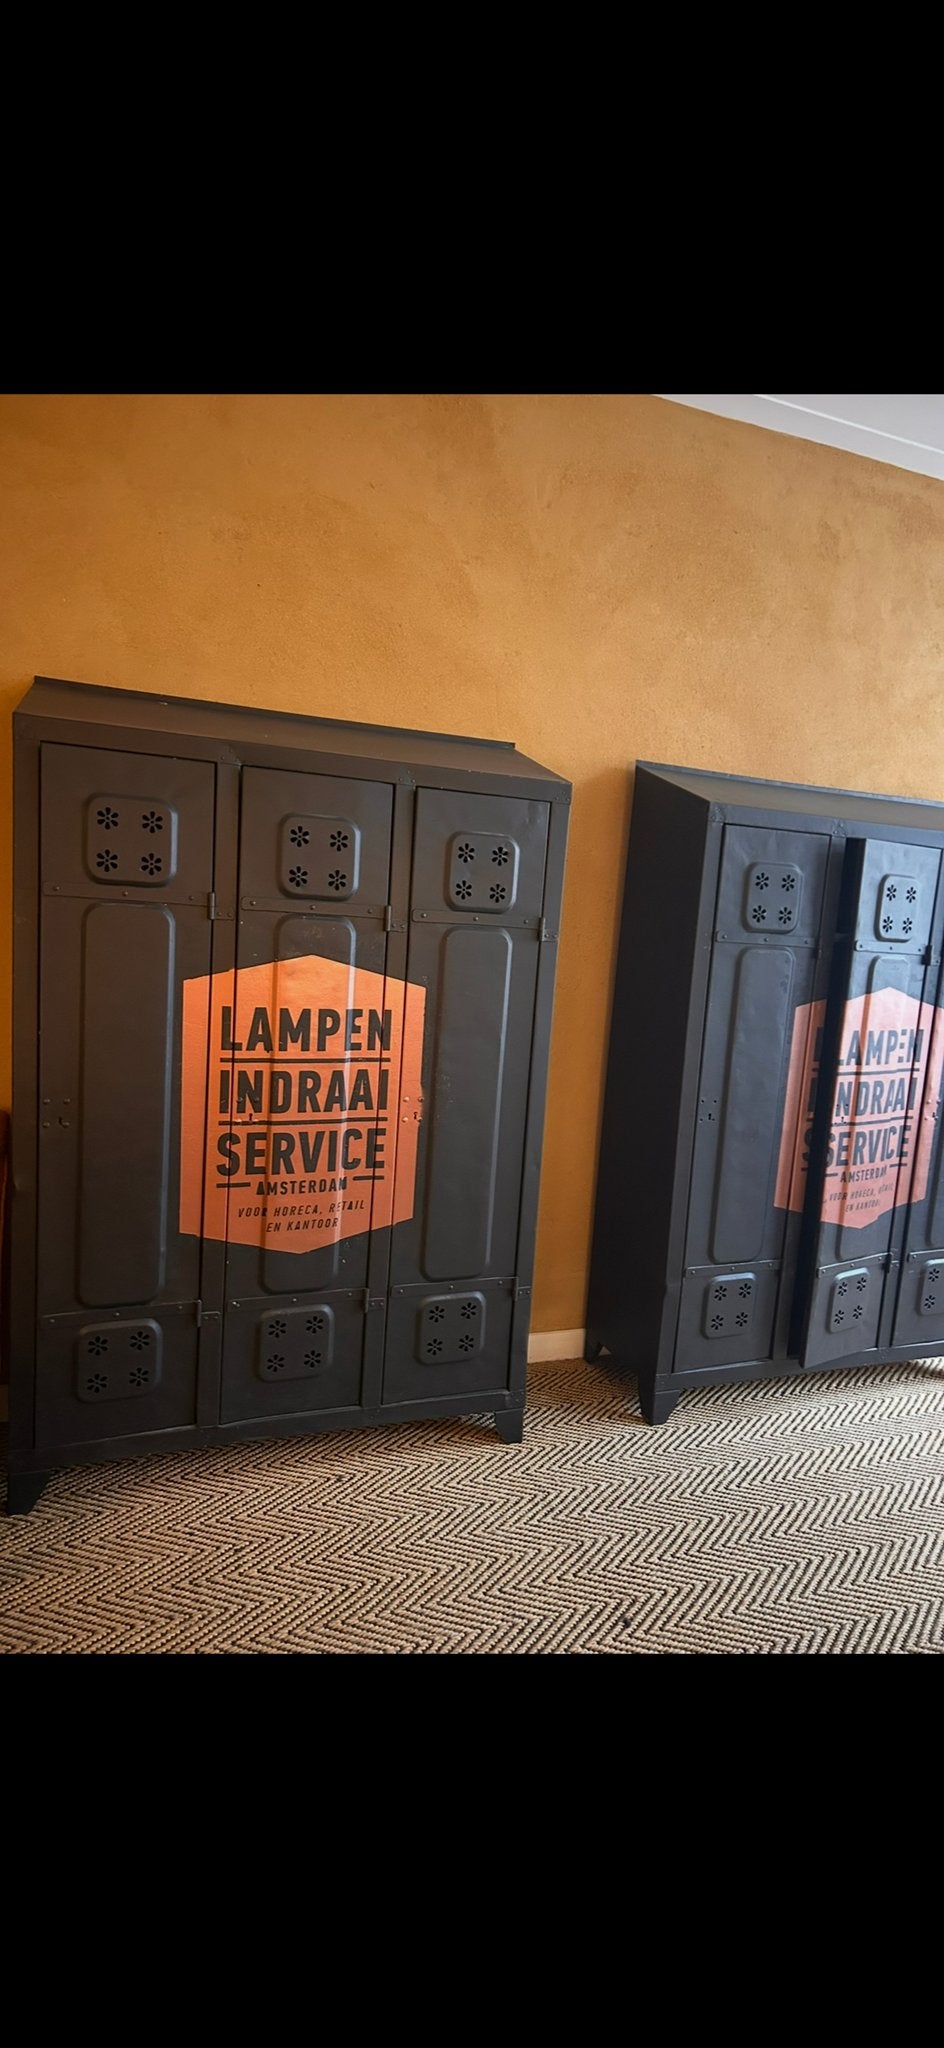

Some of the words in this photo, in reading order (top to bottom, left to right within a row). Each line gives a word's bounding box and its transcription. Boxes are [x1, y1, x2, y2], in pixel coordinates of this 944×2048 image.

[221, 1006, 392, 1053] LAMPEN
[219, 1069, 389, 1114] INDRAAI
[216, 1128, 387, 1177] SERVICE
[803, 1125, 911, 1168] SERVICE
[256, 1176, 348, 1196] AMSTERDAM
[840, 1166, 887, 1183] AMSTERDAM
[238, 1206, 267, 1218] VOOR
[273, 1204, 323, 1217] HORECA,
[329, 1199, 365, 1212] RETAIL
[266, 1222, 281, 1233] EN
[287, 1217, 339, 1231] KANTOOR
